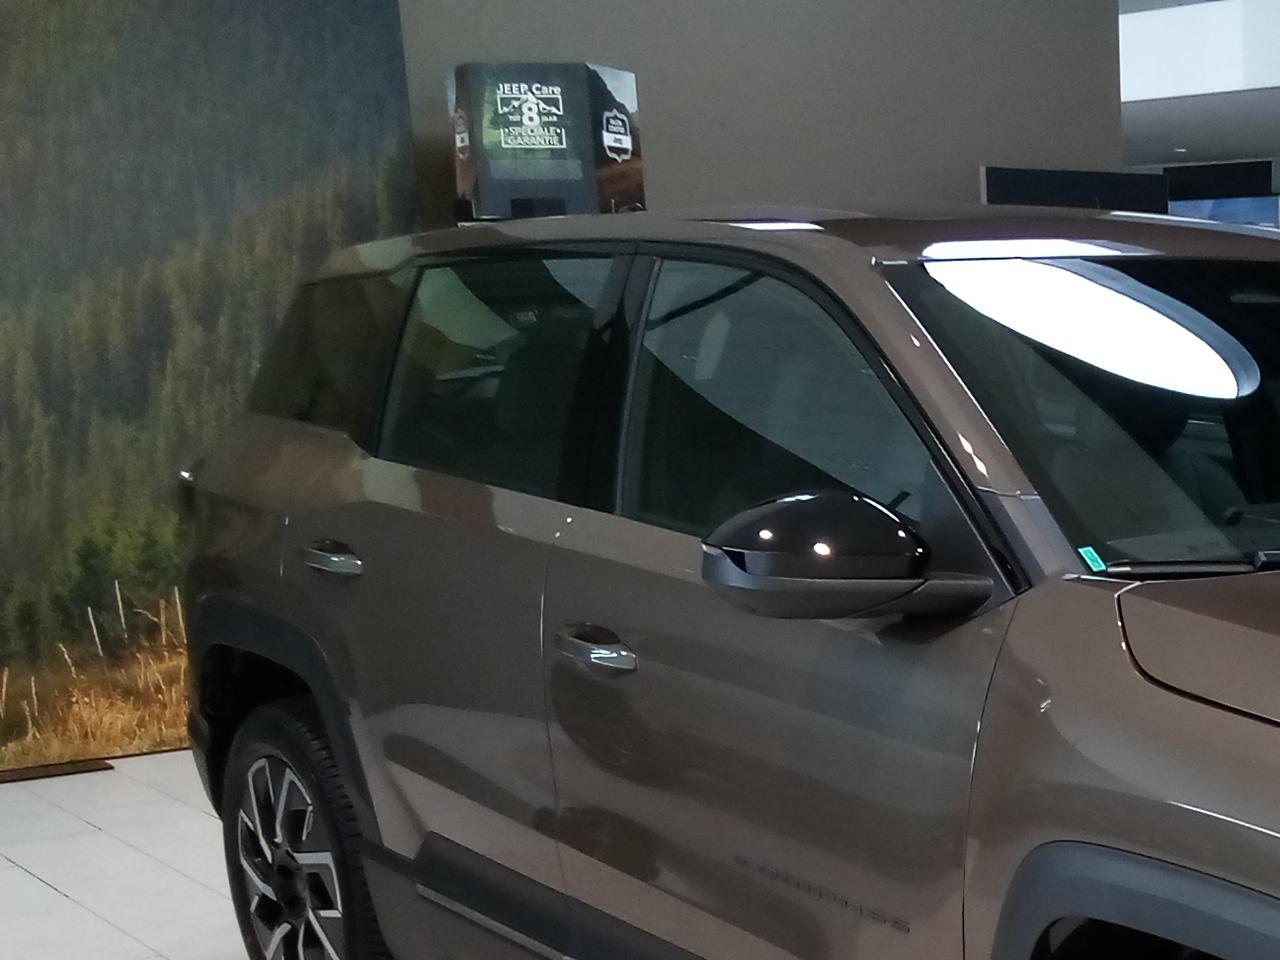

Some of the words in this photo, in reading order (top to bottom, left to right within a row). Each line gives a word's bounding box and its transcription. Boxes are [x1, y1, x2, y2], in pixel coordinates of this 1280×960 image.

[496, 83, 529, 95] JEEP
[532, 83, 562, 95] Care
[521, 101, 541, 126] 8
